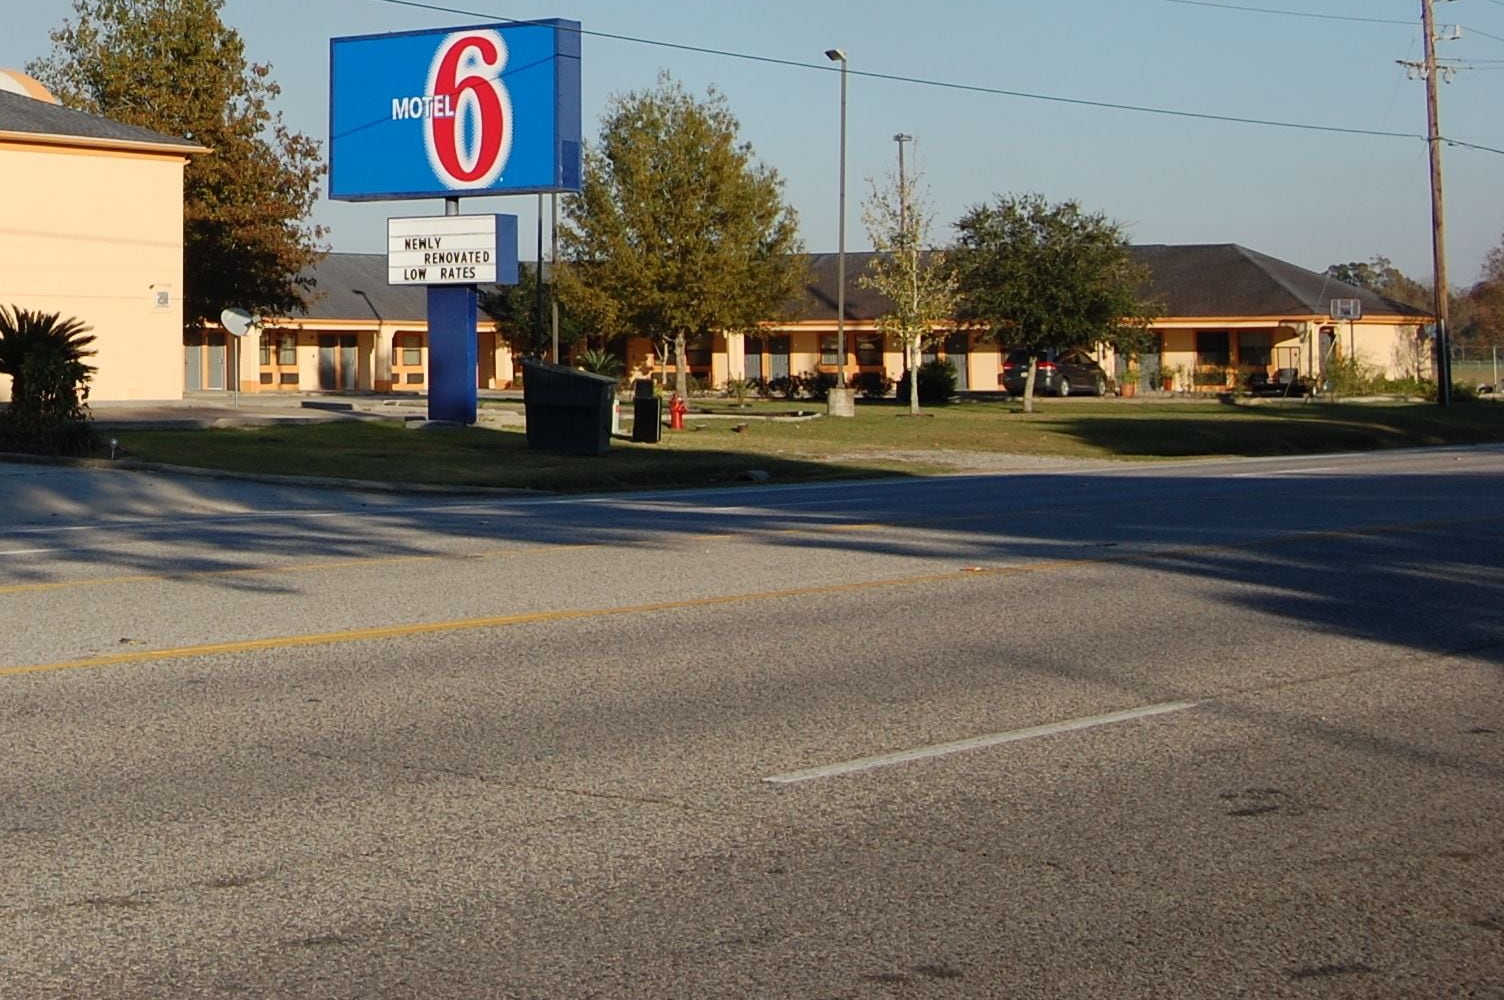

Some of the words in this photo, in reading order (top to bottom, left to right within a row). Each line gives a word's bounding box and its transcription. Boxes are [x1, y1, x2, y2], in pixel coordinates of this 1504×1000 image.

[392, 95, 455, 120] MOTEL
[431, 35, 505, 183] 6
[404, 237, 441, 250] NEWLY
[424, 251, 490, 264] RENOVATED
[404, 268, 426, 280] LOW
[440, 266, 476, 279] RATES
